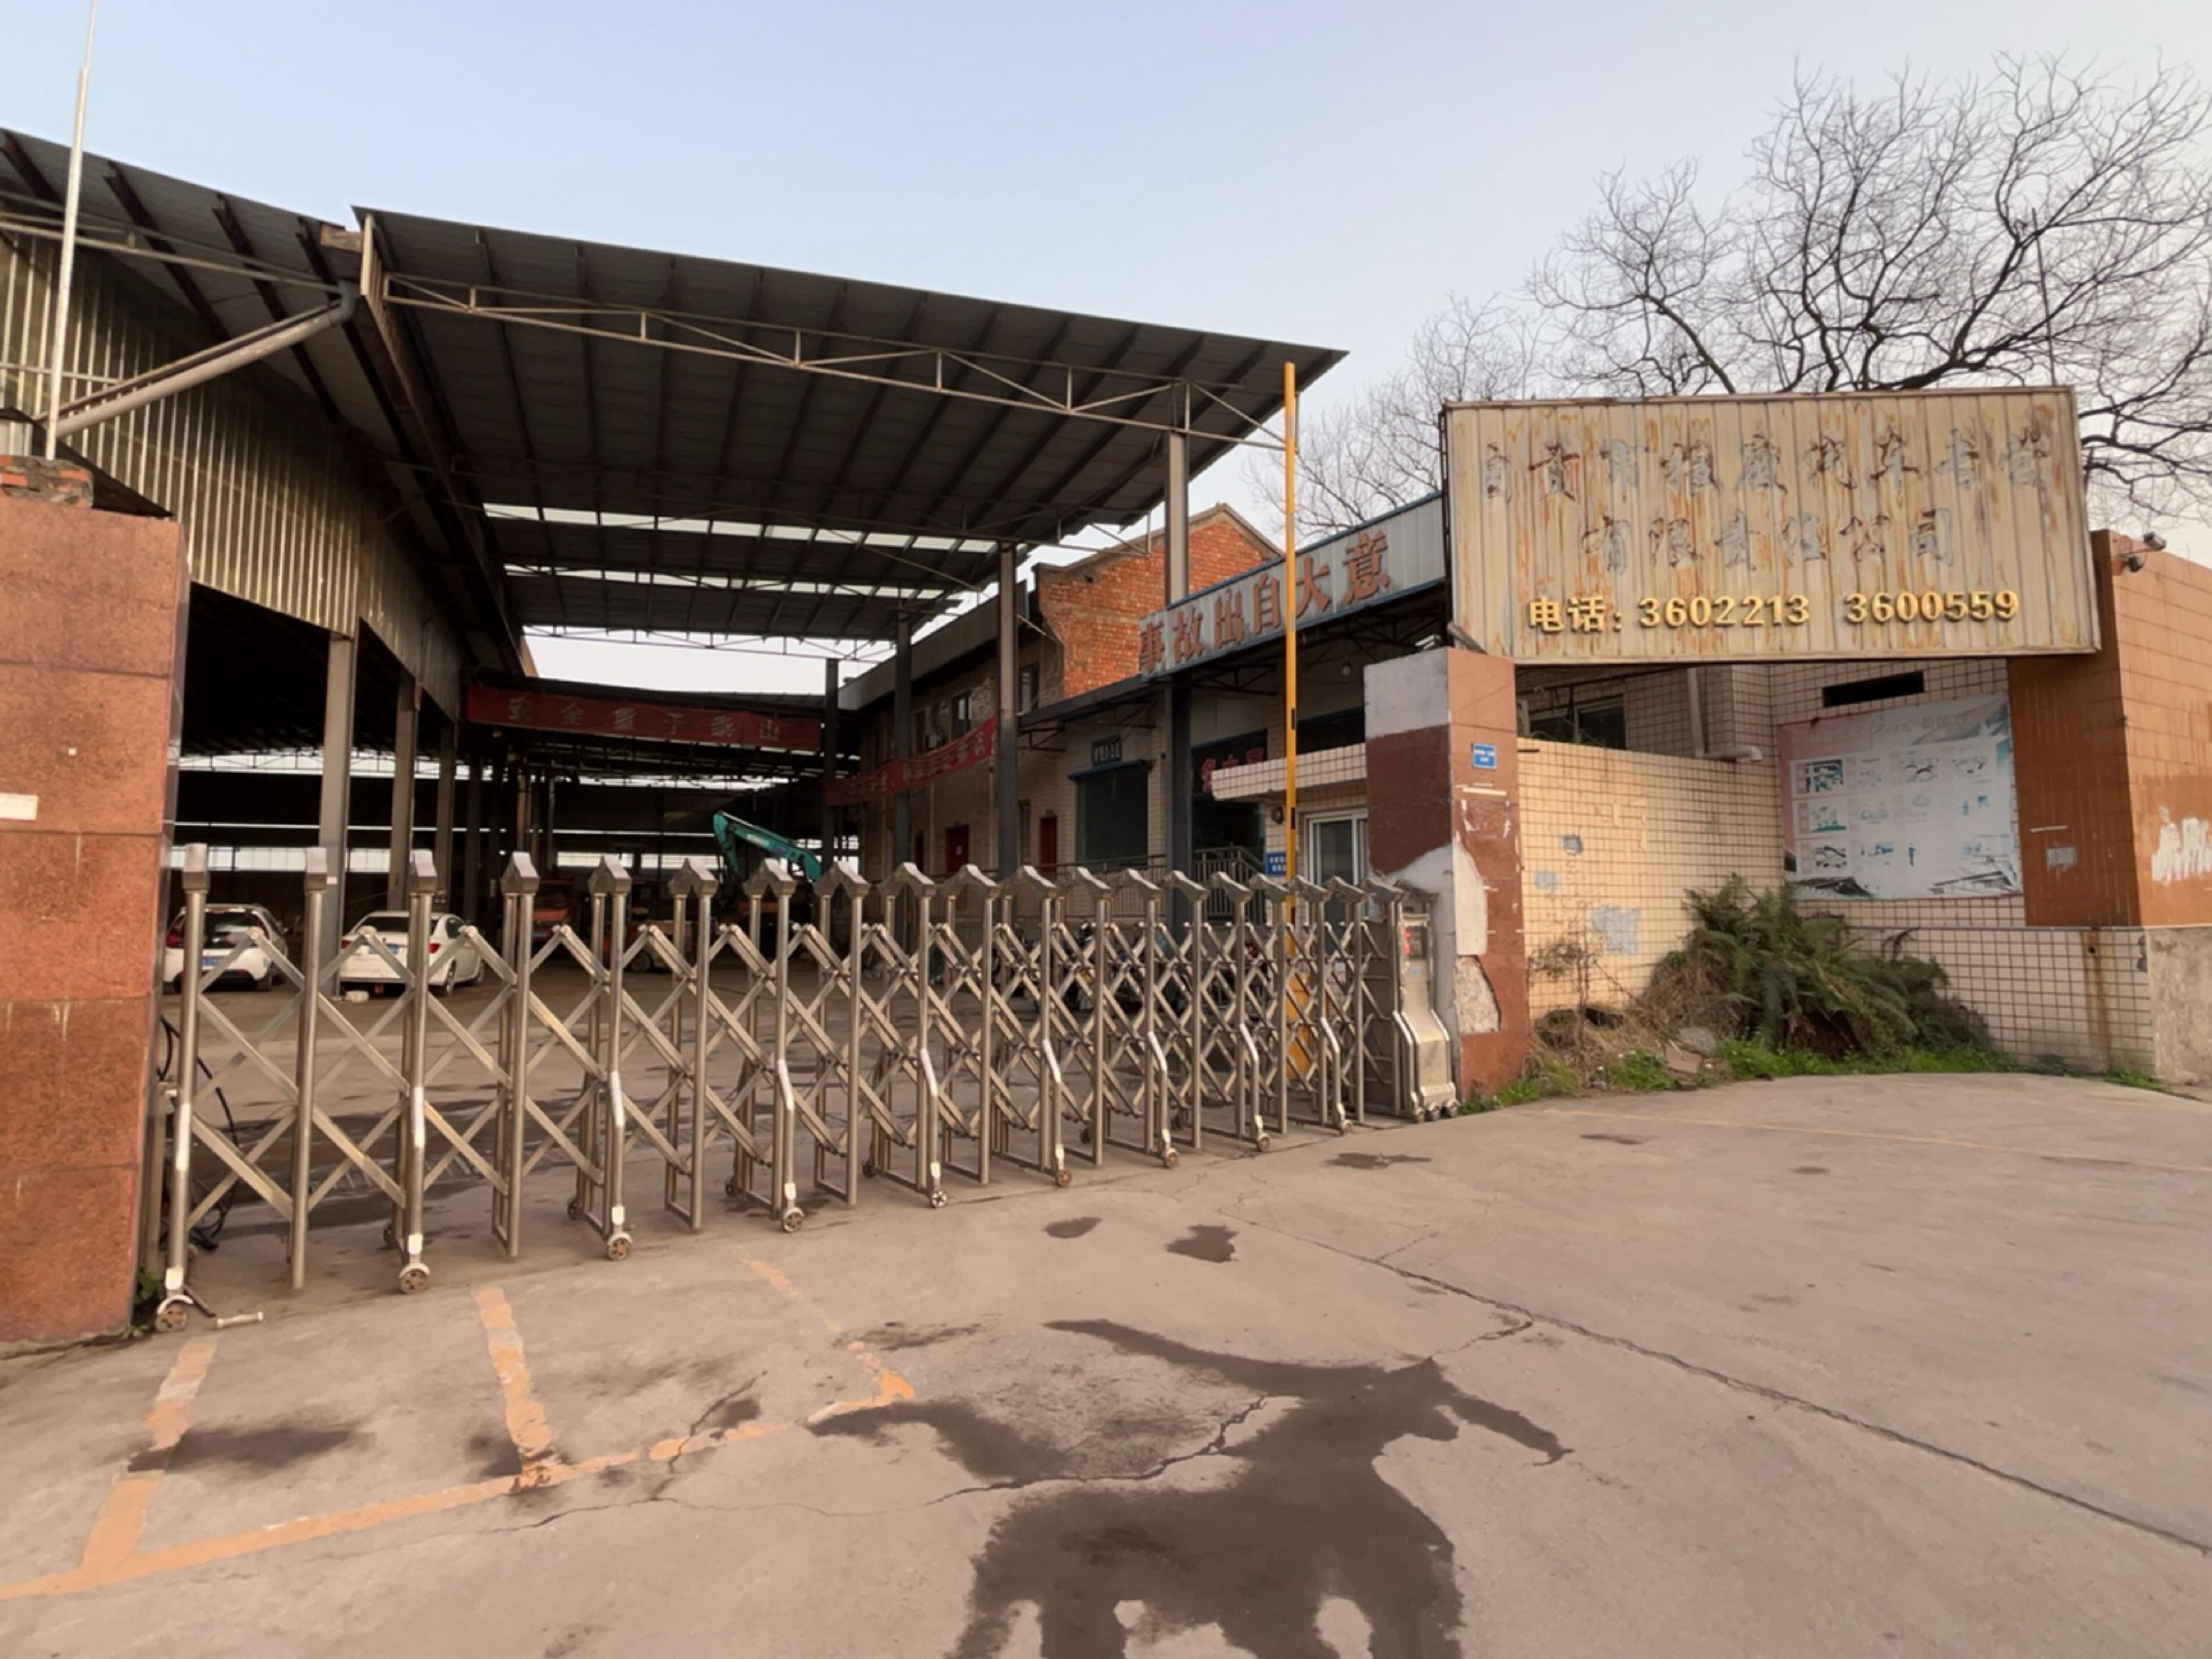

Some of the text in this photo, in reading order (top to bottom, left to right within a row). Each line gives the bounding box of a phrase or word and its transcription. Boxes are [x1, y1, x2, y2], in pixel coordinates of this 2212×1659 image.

[1580, 508, 1954, 576] 有限责任公司
[1139, 531, 1392, 675] 事故出自大意
[1638, 594, 1811, 628] 3602213
[1845, 589, 2020, 623] 3600559
[508, 696, 780, 741] 安全重于泰山
